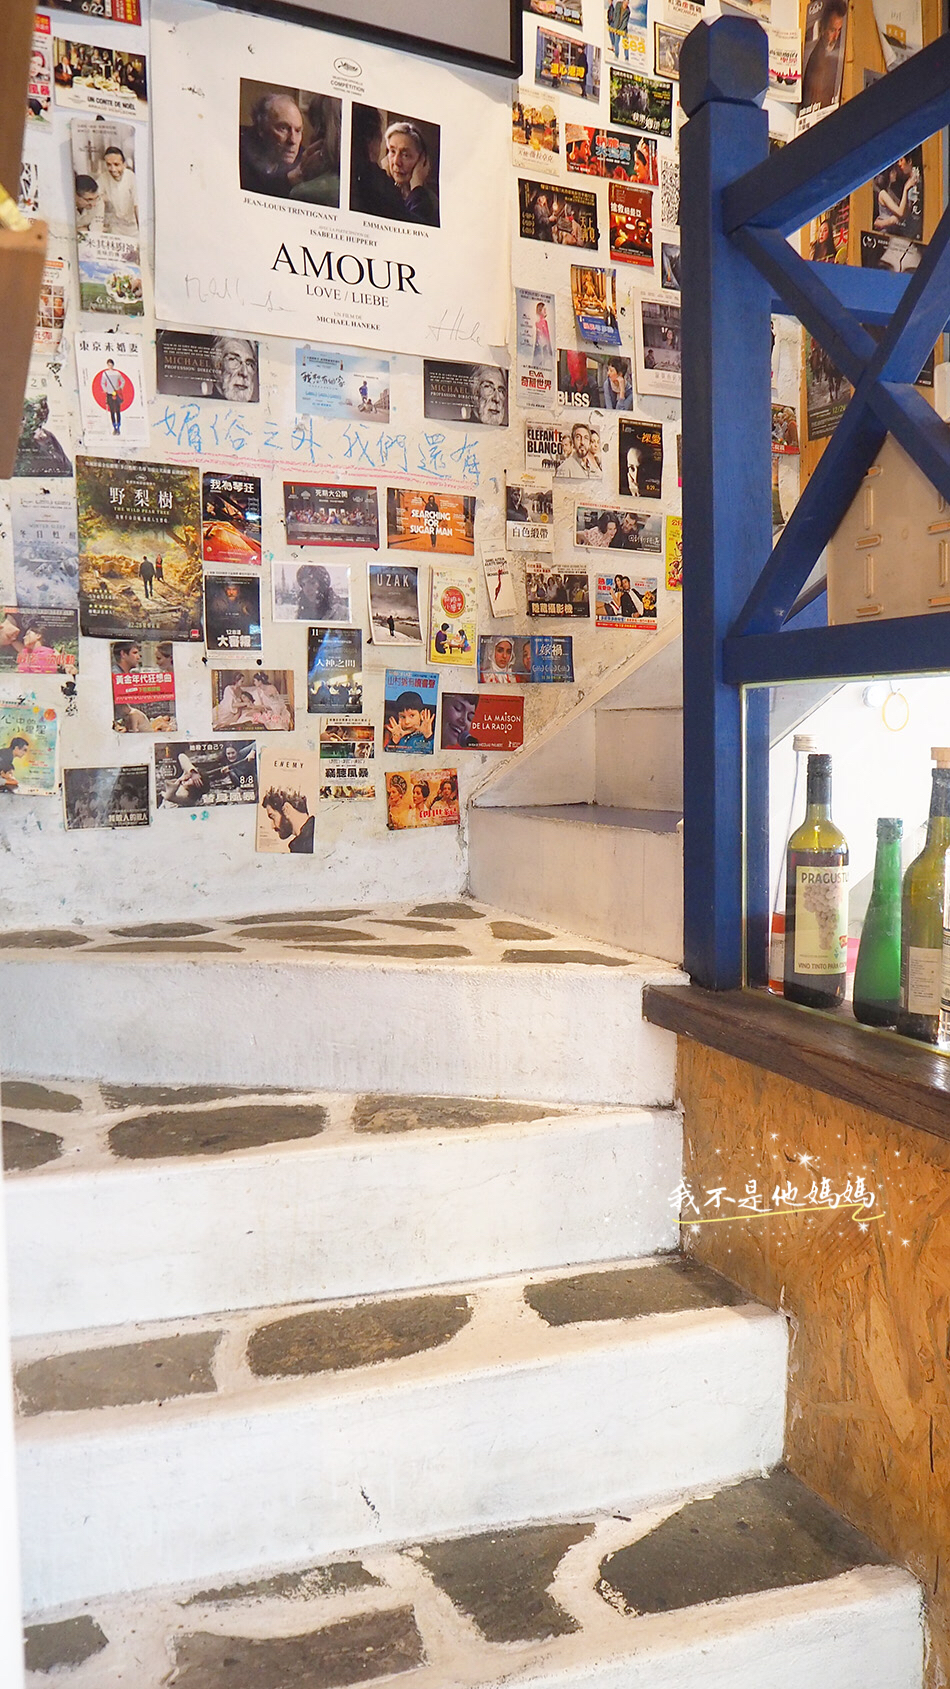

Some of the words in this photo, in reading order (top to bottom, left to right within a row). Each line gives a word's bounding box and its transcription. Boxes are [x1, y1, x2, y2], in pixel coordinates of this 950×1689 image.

[81, 4, 104, 15] 6/22
[622, 38, 646, 54] sea
[243, 197, 287, 213] JEAN-LOUIS
[288, 207, 338, 222] TRINTIGNANT
[363, 220, 411, 236] EMMANUELLE
[412, 229, 429, 239] RIVA
[310, 229, 344, 242] ISABELLE
[346, 235, 378, 247] HUPPERT
[271, 243, 422, 295] AMOUR
[306, 284, 341, 301] LOVE
[352, 292, 389, 308] LIEBE
[317, 316, 350, 327] MICHAEL
[352, 319, 380, 331] HANEKE
[80, 340, 139, 354] 東京未婚妻
[164, 356, 211, 368] MICHAEL
[529, 370, 544, 379] EVA
[430, 383, 469, 395] MICHAEL
[557, 391, 591, 408] BLISS
[527, 429, 563, 442] ELEFANTE
[527, 441, 563, 455] BLANCO
[109, 487, 174, 510] 野梨樹
[315, 488, 349, 499] 死期大公開
[411, 509, 451, 521] SEARCHING
[424, 519, 439, 528] FOR
[409, 526, 434, 535] SUGAR
[436, 527, 453, 537] MAN
[512, 526, 549, 539] 白色緞帶
[376, 573, 410, 588] UZAK
[316, 658, 357, 669] 人神之間
[115, 673, 172, 685] 黃金年代狂想曲
[494, 712, 521, 722] MAISON
[472, 722, 481, 730] DE
[492, 723, 513, 733] RADIO
[274, 760, 304, 769] ENEMY
[325, 768, 369, 778] 竊聽風暴
[239, 775, 254, 784] 8/8
[798, 961, 811, 970] VINO
[811, 961, 827, 970] TINTO
